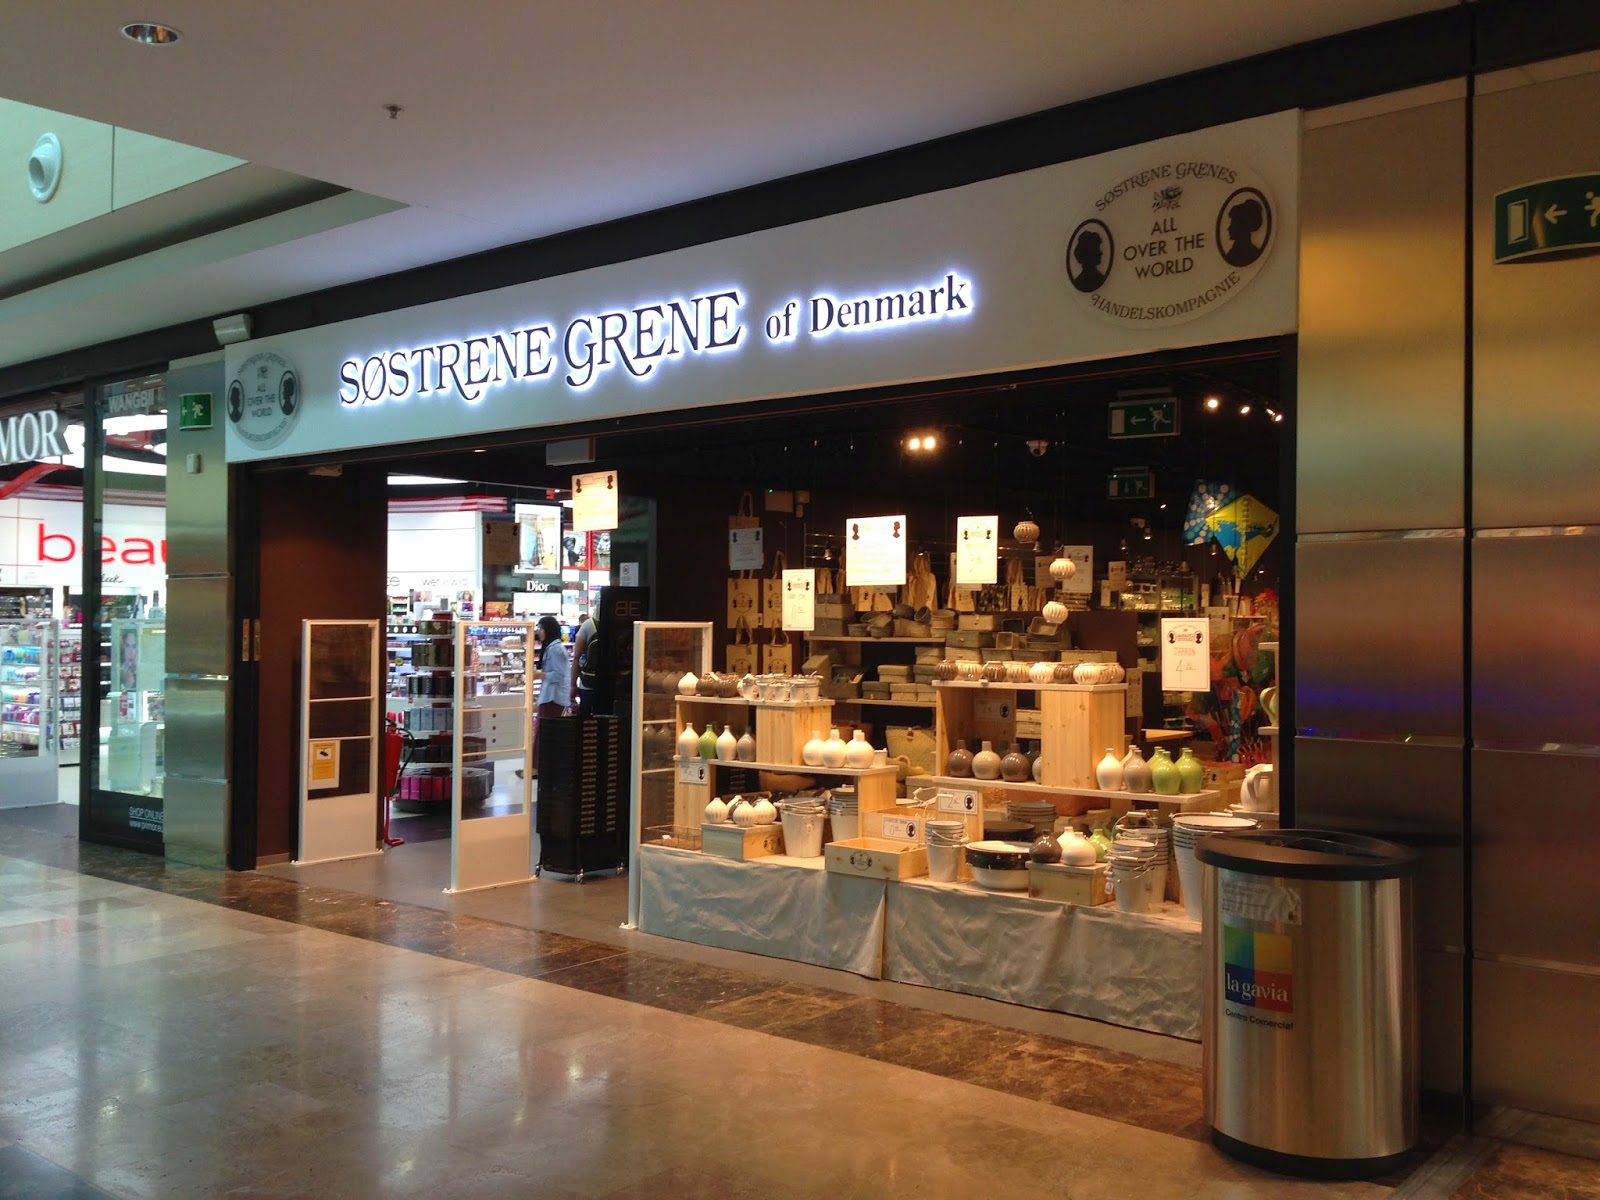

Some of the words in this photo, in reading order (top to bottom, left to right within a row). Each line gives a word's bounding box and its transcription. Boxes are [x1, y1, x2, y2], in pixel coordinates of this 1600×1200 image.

[1094, 163, 1172, 212] SØSTRENE
[1175, 162, 1239, 185] GRENES
[1150, 217, 1177, 236] ALL
[1123, 240, 1168, 262] OVER
[1174, 232, 1206, 252] THE
[1135, 257, 1194, 280] WORLD
[1090, 271, 1241, 321] HANDELSKOMPAGNIE
[339, 326, 553, 407] SØSTRENE
[564, 290, 743, 388] GRENE
[765, 302, 796, 341] of
[808, 273, 969, 333] Denmark
[37, 523, 167, 565] bea
[526, 580, 549, 591] Dior
[1226, 972, 1240, 992] la
[1241, 981, 1289, 1003] gavia
[1225, 1008, 1249, 1023] Centro
[1249, 1014, 1294, 1031] Comercial
